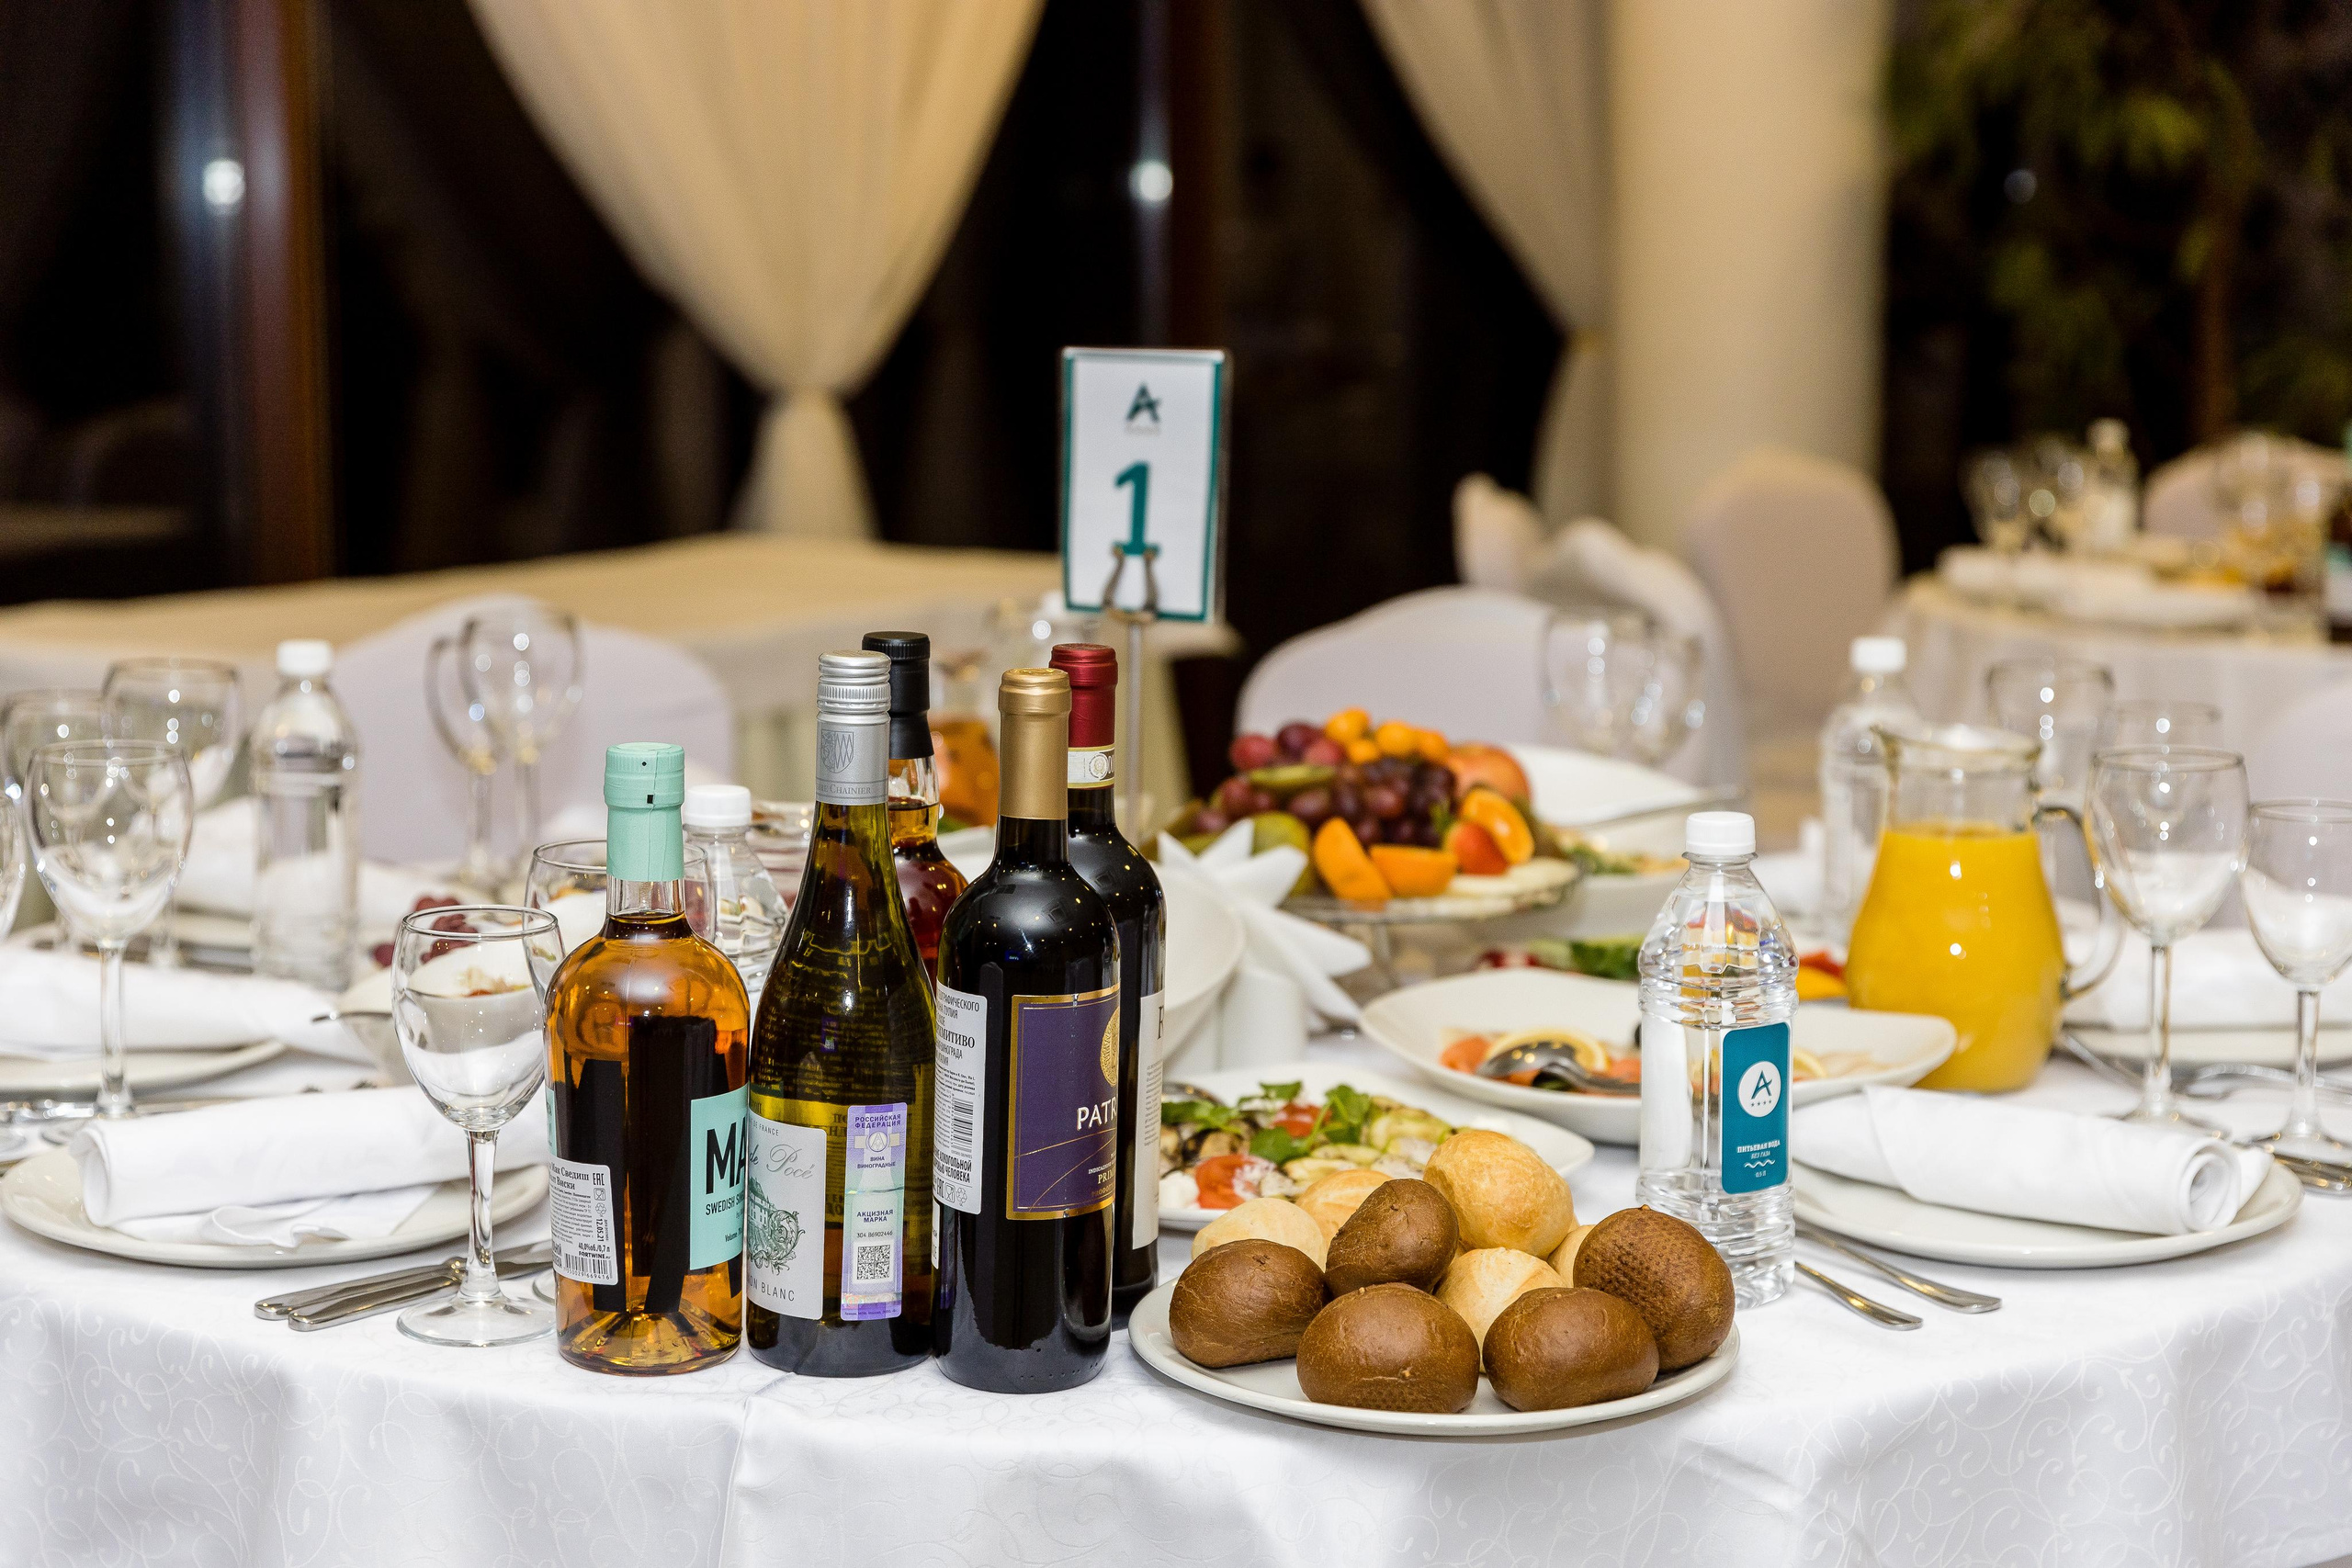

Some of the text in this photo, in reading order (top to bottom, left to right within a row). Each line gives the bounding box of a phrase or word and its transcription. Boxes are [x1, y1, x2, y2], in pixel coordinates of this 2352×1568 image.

[1113, 460, 1160, 556] 1
[1751, 1069, 1773, 1100] A
[854, 1114, 901, 1122] РОССИЙСКАЯ
[854, 1121, 901, 1129] ФЕДЕРАЦИЯ
[759, 1123, 779, 1137] FRANCE
[1736, 1139, 1781, 1154] ПИТЬЕВАЯ ВОДА
[766, 1144, 816, 1179] Pocé
[857, 1161, 896, 1169] ВИНОГРАДНЫЕ
[560, 1167, 590, 1181] Сведиш
[944, 1166, 970, 1183] ЧЕЛОВЕКА
[557, 1177, 576, 1190] Виски
[706, 1196, 736, 1216] SWEDISH
[856, 1209, 894, 1217] АКЦИЗНАЯ
[595, 1218, 605, 1242] 12.05.21
[761, 1281, 795, 1302] BLANC
